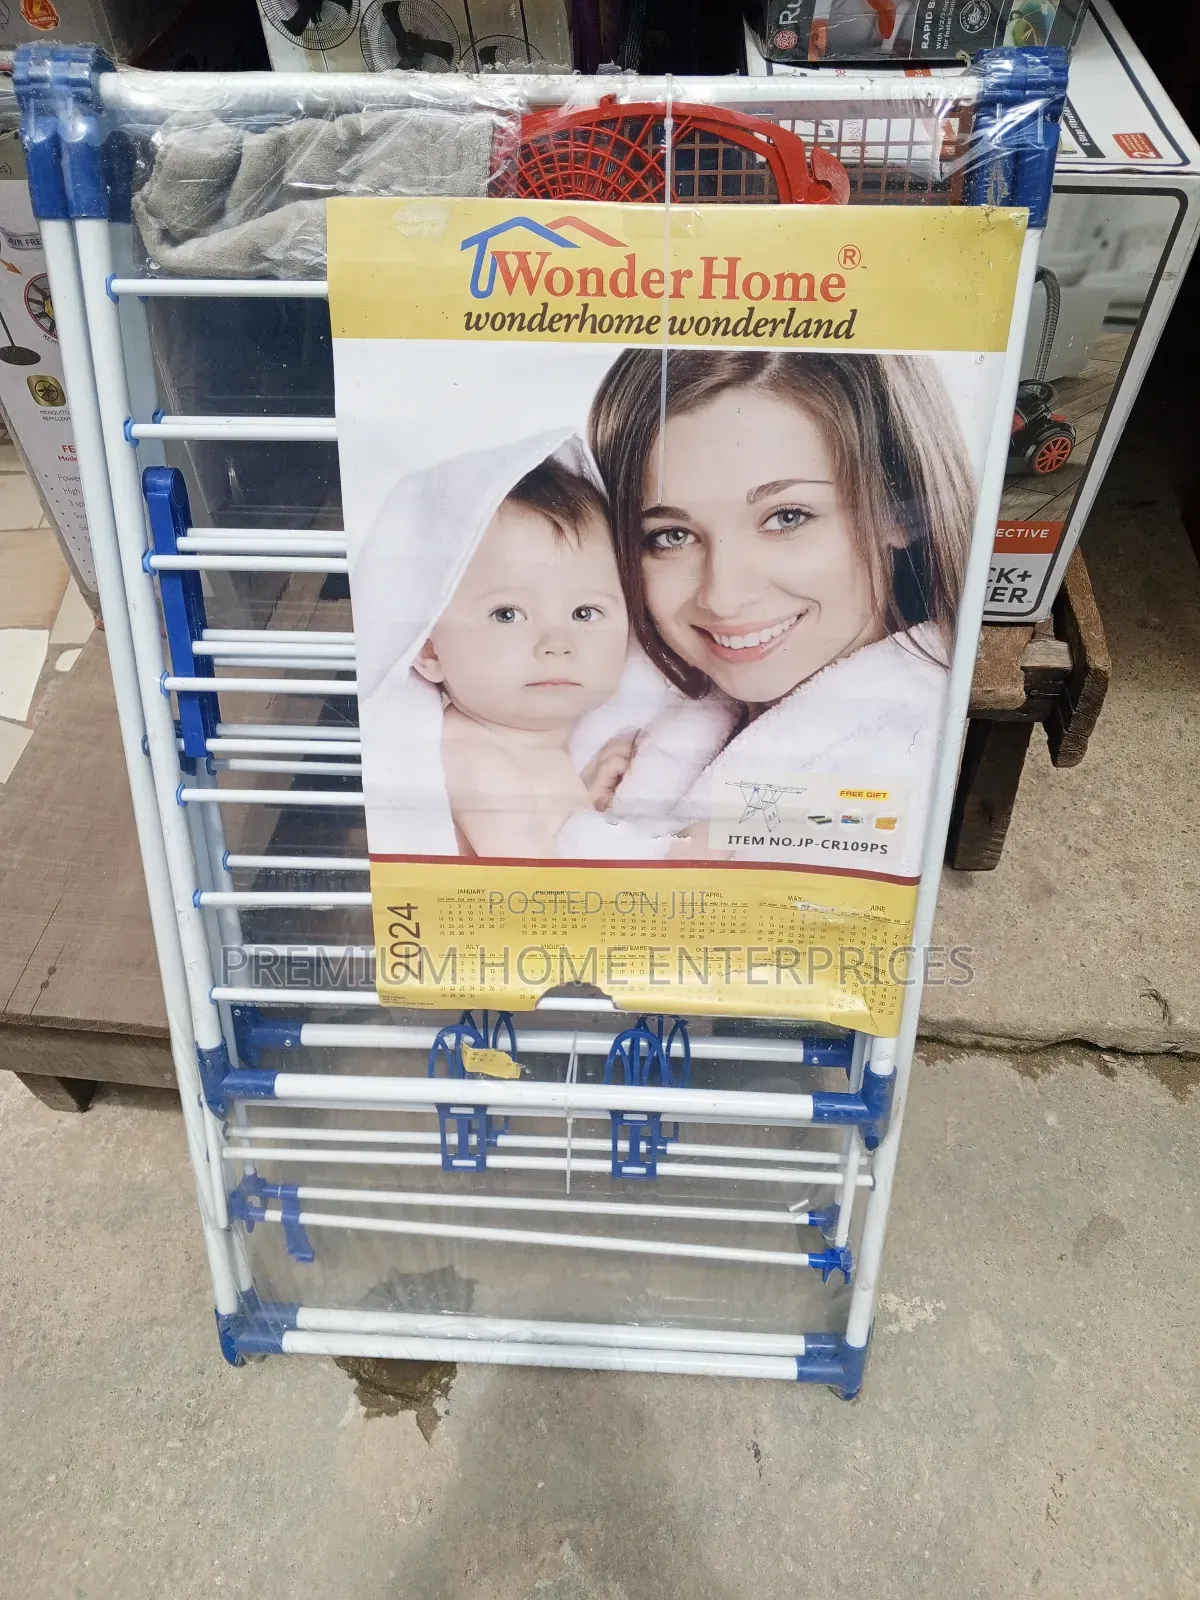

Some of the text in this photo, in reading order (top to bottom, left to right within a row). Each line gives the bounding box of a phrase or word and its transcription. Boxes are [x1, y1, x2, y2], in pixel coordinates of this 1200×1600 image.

[921, 12, 933, 49] RAPID
[7, 238, 24, 247] AIR
[463, 302, 859, 340] wonderhome wonderland
[839, 790, 888, 799] FREE GIFT
[727, 835, 765, 846] ITEM
[387, 903, 422, 980] 2024
